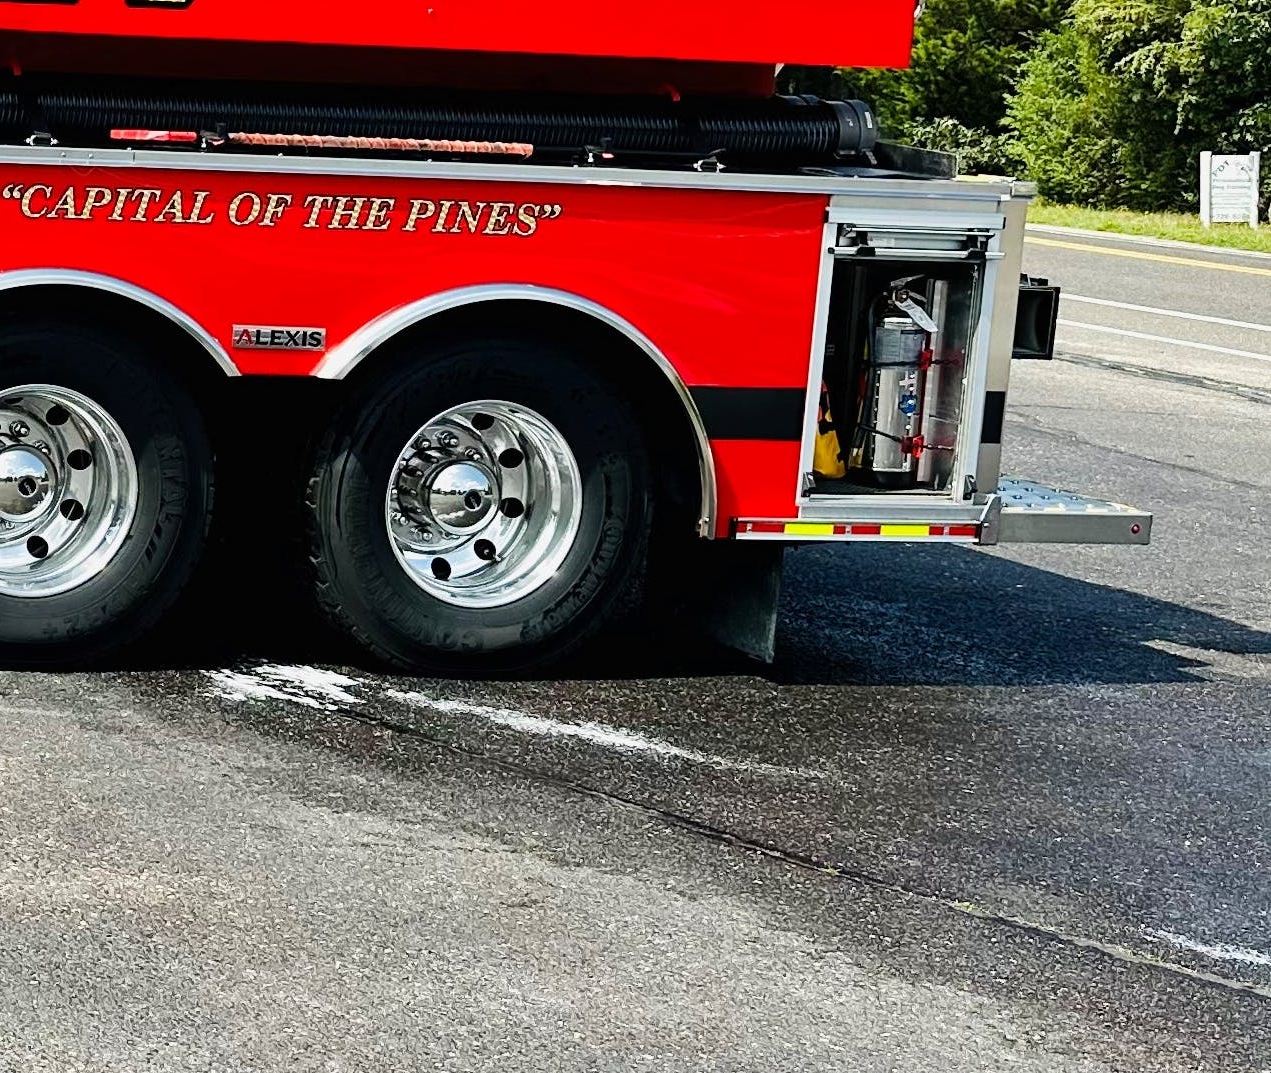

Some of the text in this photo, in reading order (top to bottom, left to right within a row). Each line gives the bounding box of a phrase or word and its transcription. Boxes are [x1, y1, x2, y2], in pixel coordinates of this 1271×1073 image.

[1, 183, 563, 239] “CAPITAL OF THE PINES”
[236, 328, 324, 349] ALEXIS
